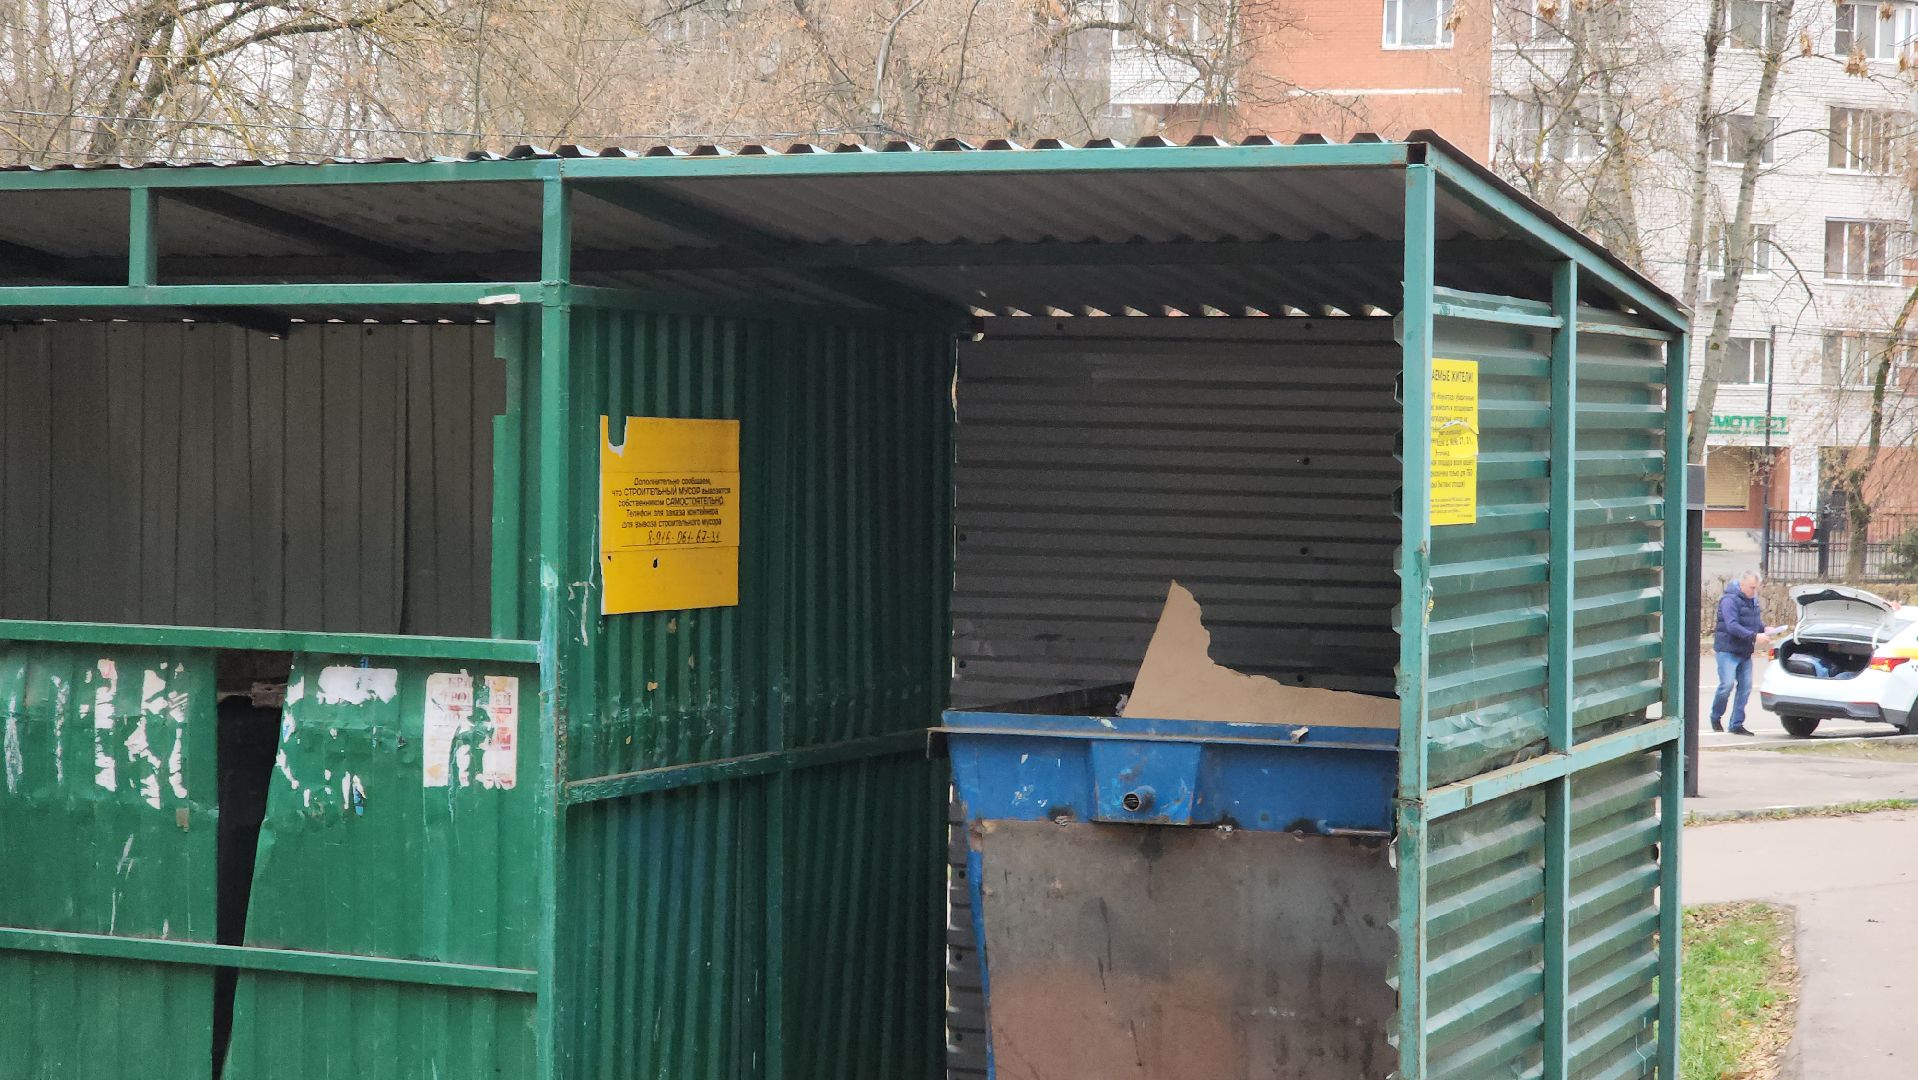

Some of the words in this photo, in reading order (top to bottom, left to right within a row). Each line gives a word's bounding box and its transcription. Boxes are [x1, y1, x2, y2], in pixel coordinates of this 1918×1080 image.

[634, 477, 680, 486] Дополнительно
[624, 486, 678, 496] СТРОИТЕЛЬНЫЙ
[678, 486, 701, 495] МУСОР
[618, 498, 665, 507] собственником
[626, 508, 652, 518] Телефон
[665, 509, 685, 517] заказа
[687, 507, 719, 516] контейнера
[621, 521, 633, 529] для
[635, 520, 657, 528] вывоза
[658, 518, 701, 528] строительного
[702, 518, 722, 527] мусора
